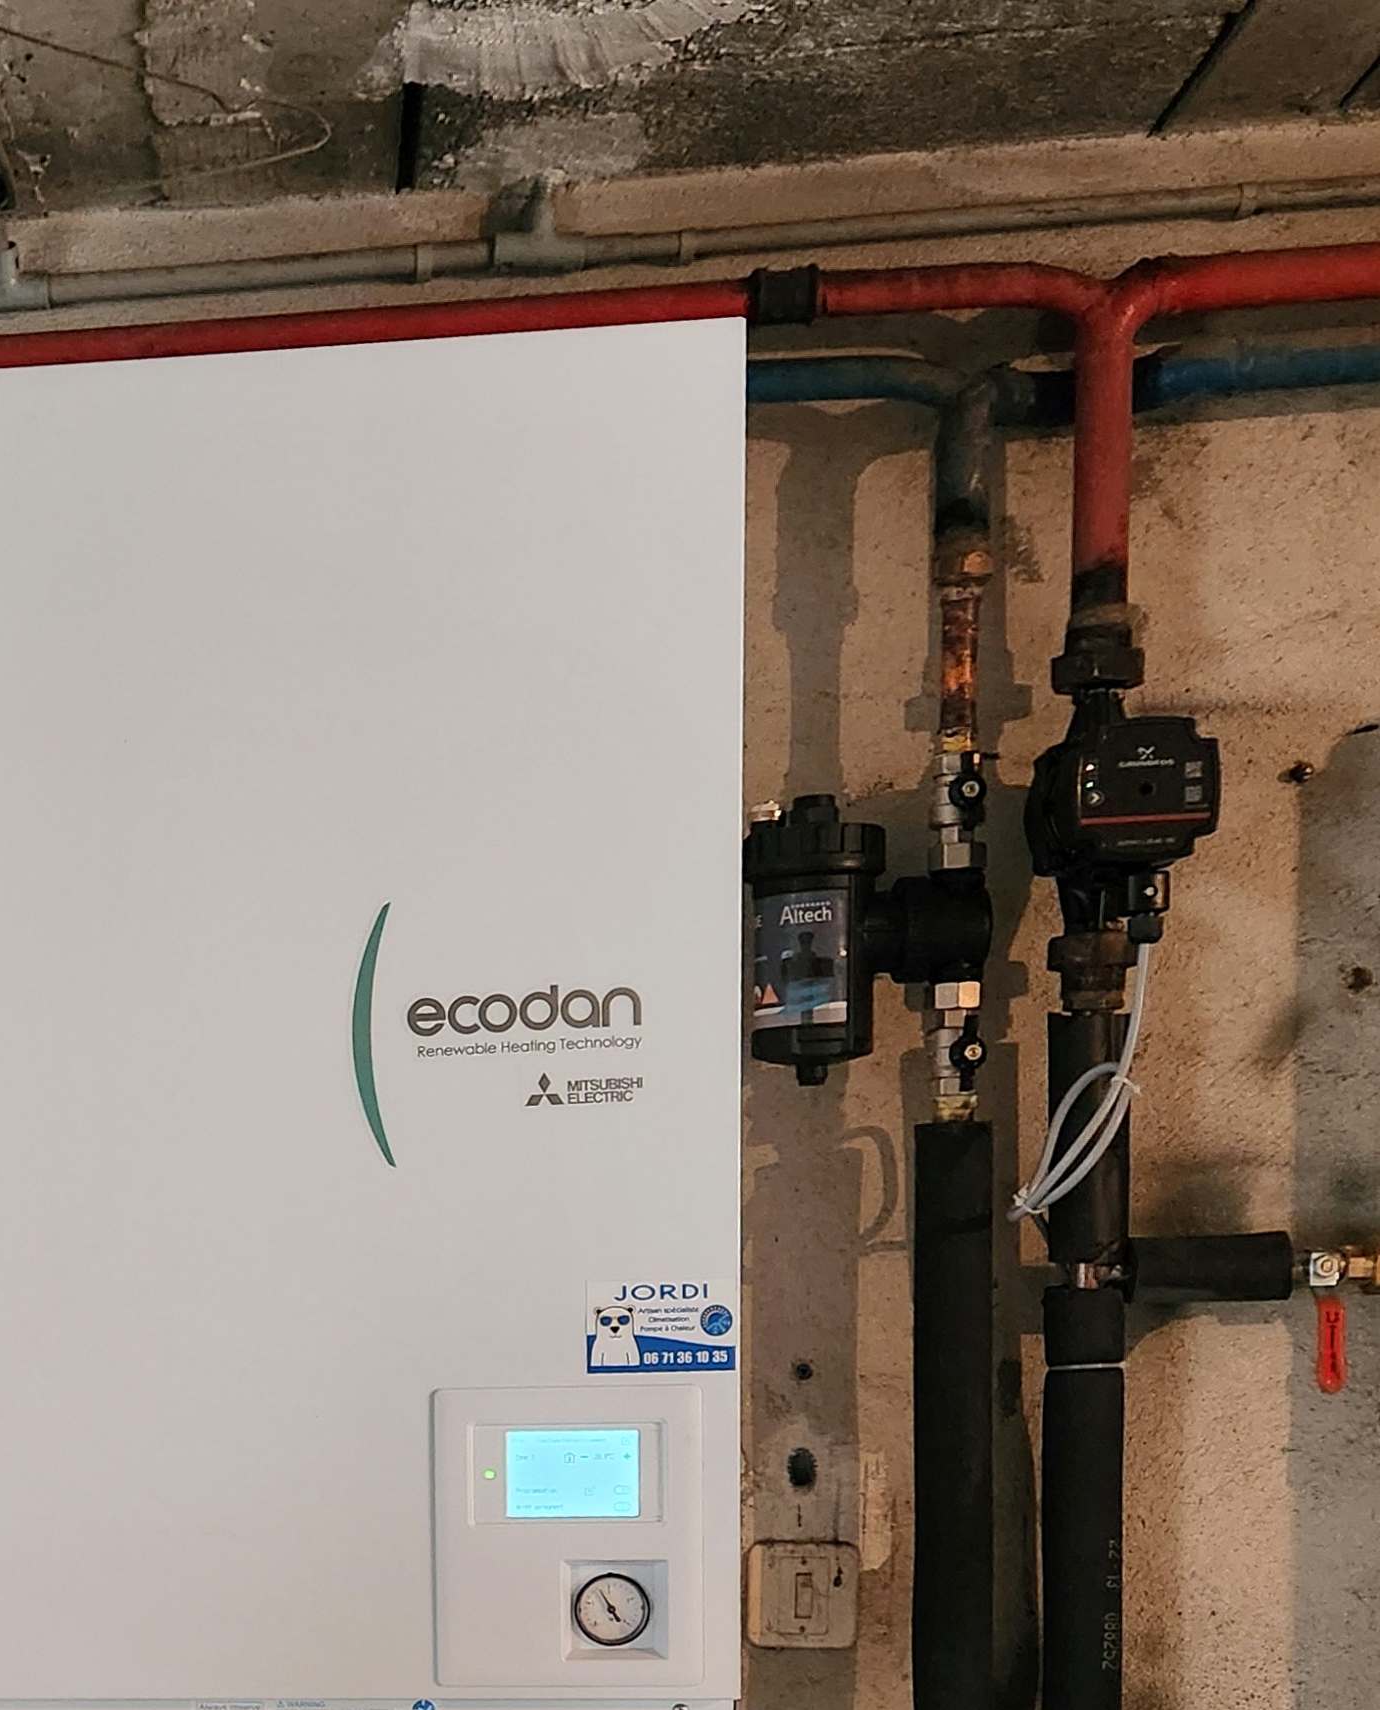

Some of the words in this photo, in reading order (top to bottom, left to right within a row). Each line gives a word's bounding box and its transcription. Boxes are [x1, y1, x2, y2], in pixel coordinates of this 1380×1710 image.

[779, 904, 832, 926] Altech
[406, 984, 643, 1037] ecodan
[416, 1040, 498, 1059] Renewable
[500, 1037, 557, 1055] Heating
[558, 1034, 643, 1052] Technology
[566, 1076, 644, 1092] MITSUBISHI
[566, 1089, 634, 1105] ELECTRIC
[613, 1282, 709, 1302] JORDI
[643, 1352, 659, 1365] 06
[661, 1351, 675, 1365] 71
[677, 1351, 693, 1364] 36
[696, 1350, 710, 1363] 10
[712, 1350, 729, 1363] 35
